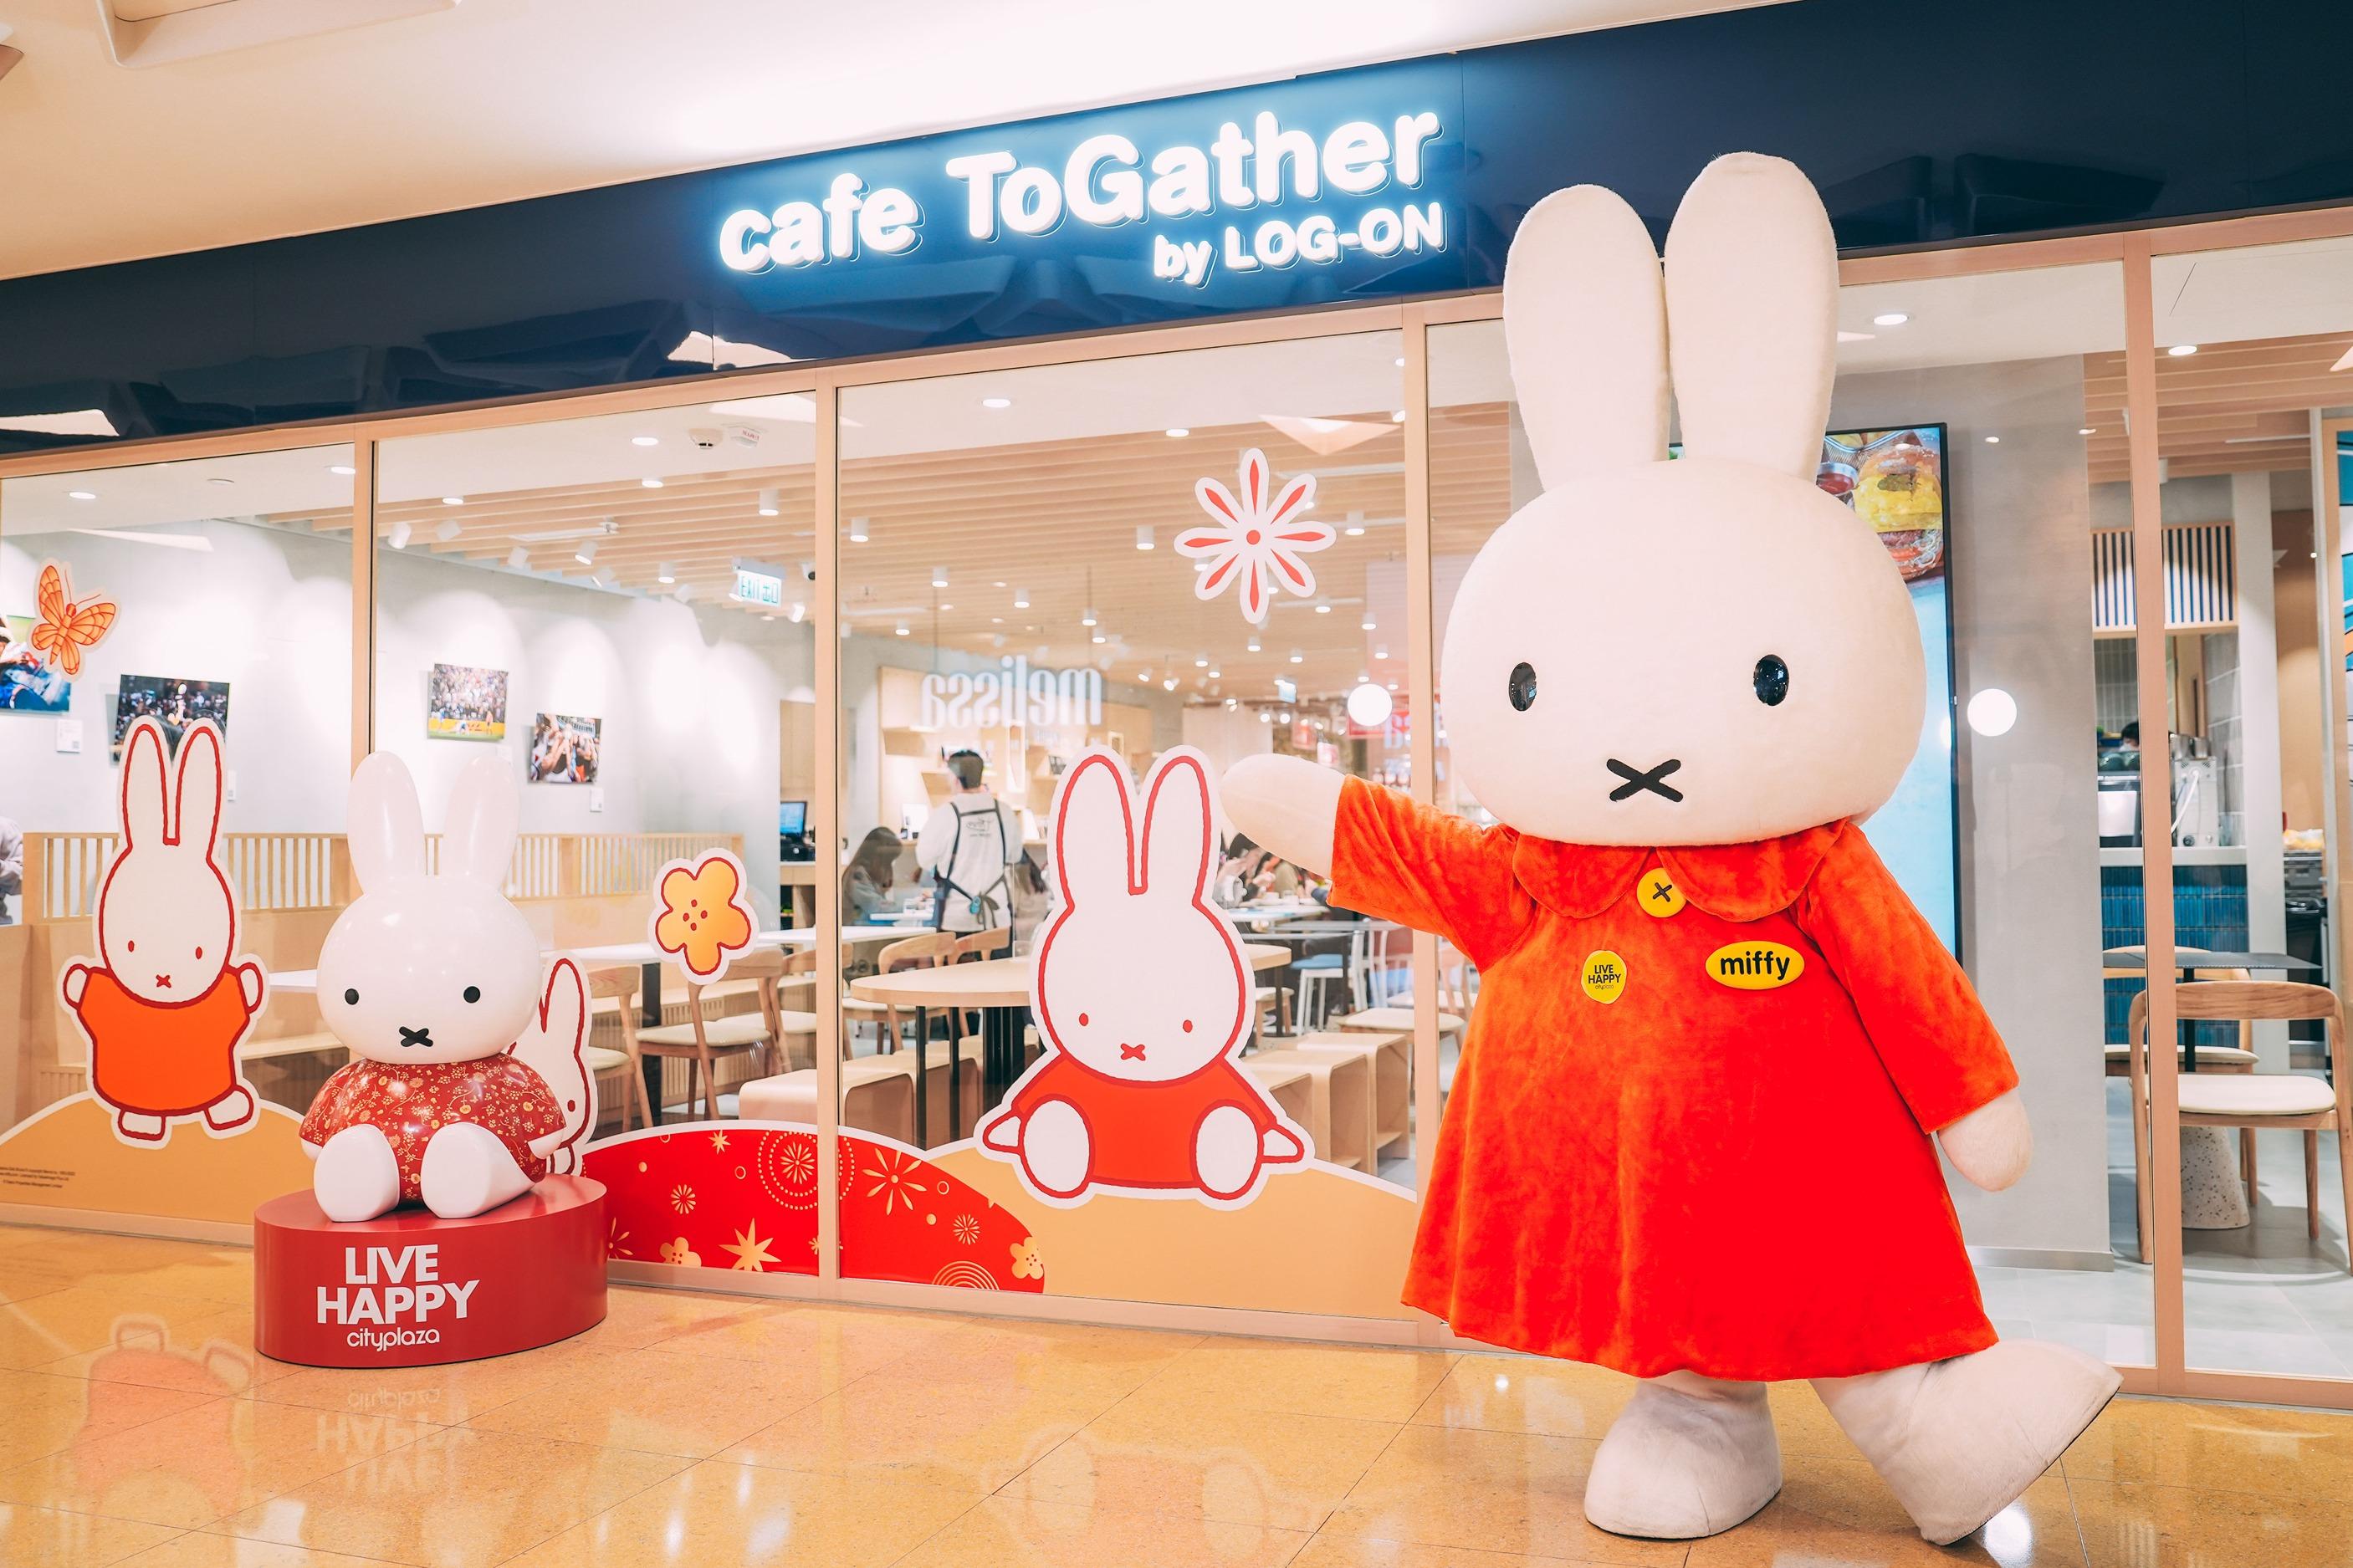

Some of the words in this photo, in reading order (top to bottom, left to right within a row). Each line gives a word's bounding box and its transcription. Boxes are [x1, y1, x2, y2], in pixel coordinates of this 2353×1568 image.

[720, 172, 922, 273] cafe
[945, 111, 1442, 241] ToGather
[1153, 235, 1215, 287] by
[1225, 202, 1445, 269] LOG-ON
[1588, 973, 1621, 983] HAPPY
[1594, 964, 1614, 974] LIVE
[1720, 950, 1790, 980] miffy
[345, 1244, 438, 1285] LIVE
[317, 1279, 480, 1325] HAPPY
[346, 1326, 440, 1351] cityplaza
